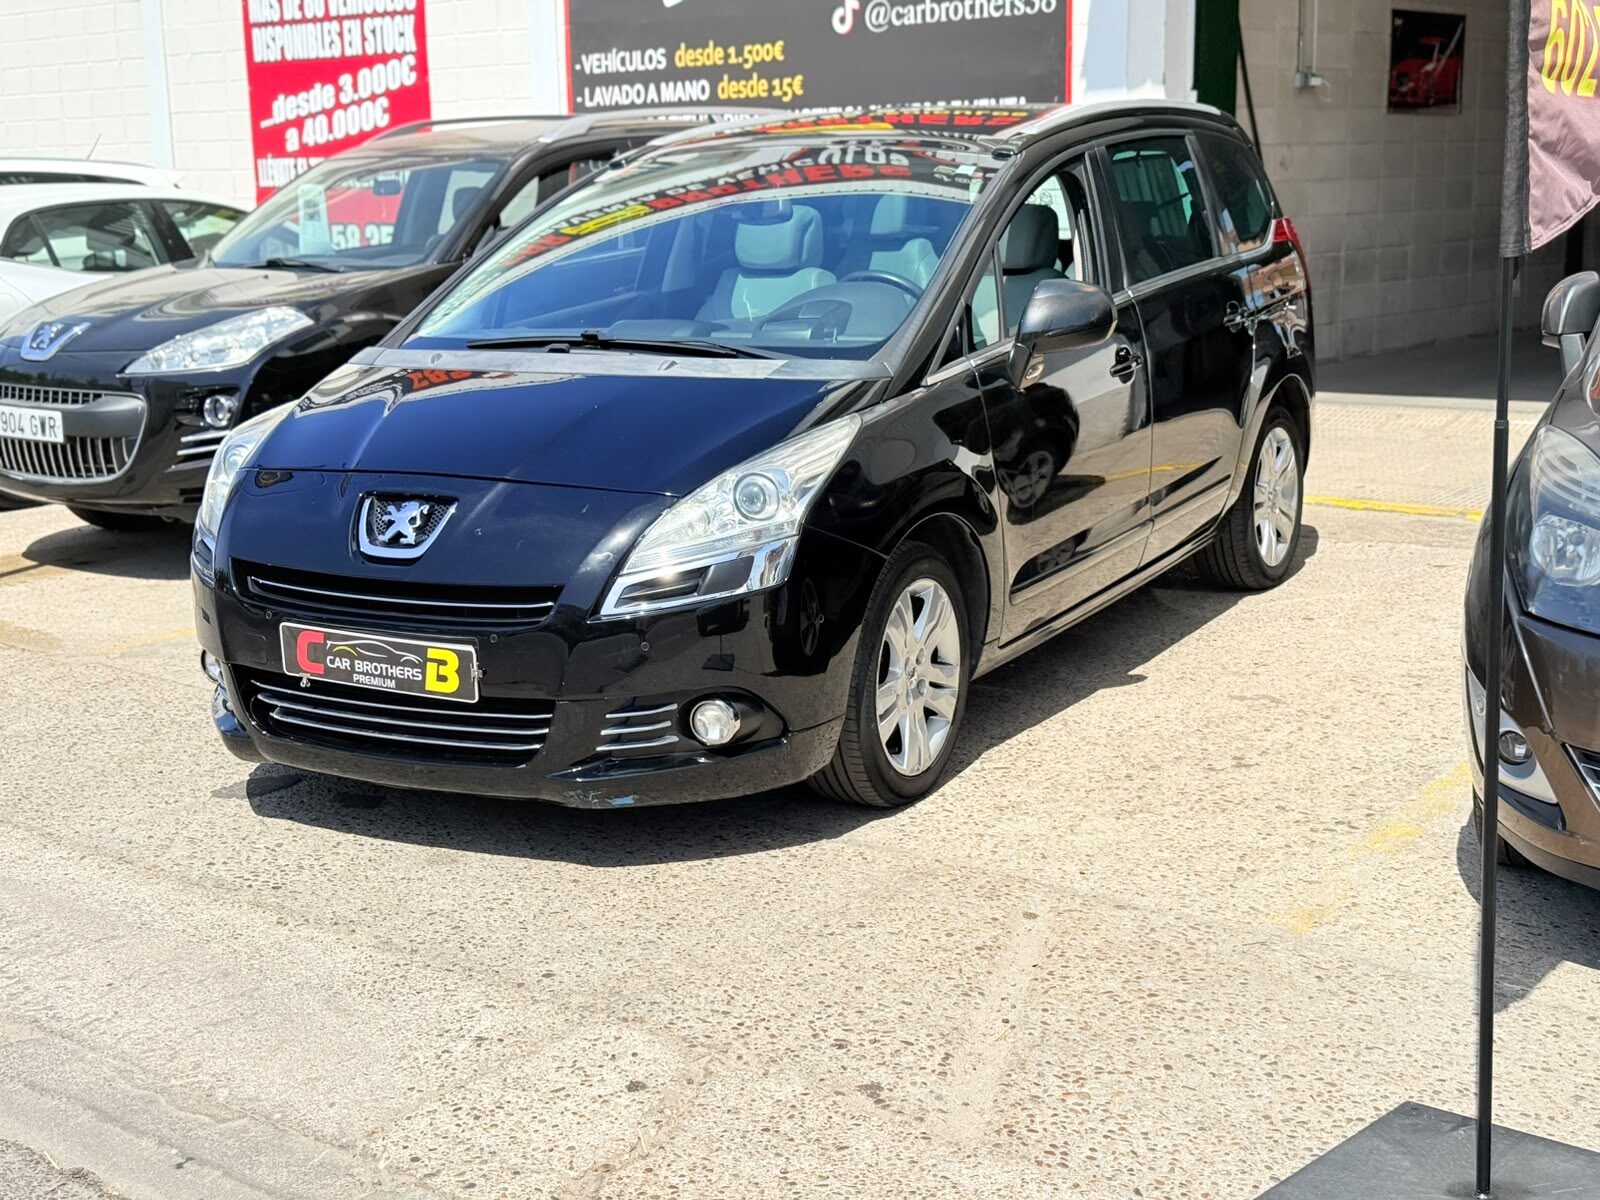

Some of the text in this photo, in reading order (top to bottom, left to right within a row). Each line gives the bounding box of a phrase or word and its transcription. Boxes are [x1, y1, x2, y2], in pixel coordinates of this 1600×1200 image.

[251, 14, 417, 63] DISPONIBLES EN STOCK
[674, 40, 724, 68] desde
[727, 40, 785, 69] 1.500€
[1541, 0, 1600, 97] 602
[338, 54, 417, 105] 3.000€
[584, 72, 804, 107] LAVADO A MANO desde 15€
[285, 96, 390, 153] a 40.000€
[0, 411, 57, 439] 904 GWR
[296, 630, 325, 675] C
[326, 655, 423, 681] CAR BROTHERS
[425, 647, 460, 693] B
[353, 673, 396, 689] PREMIUM
